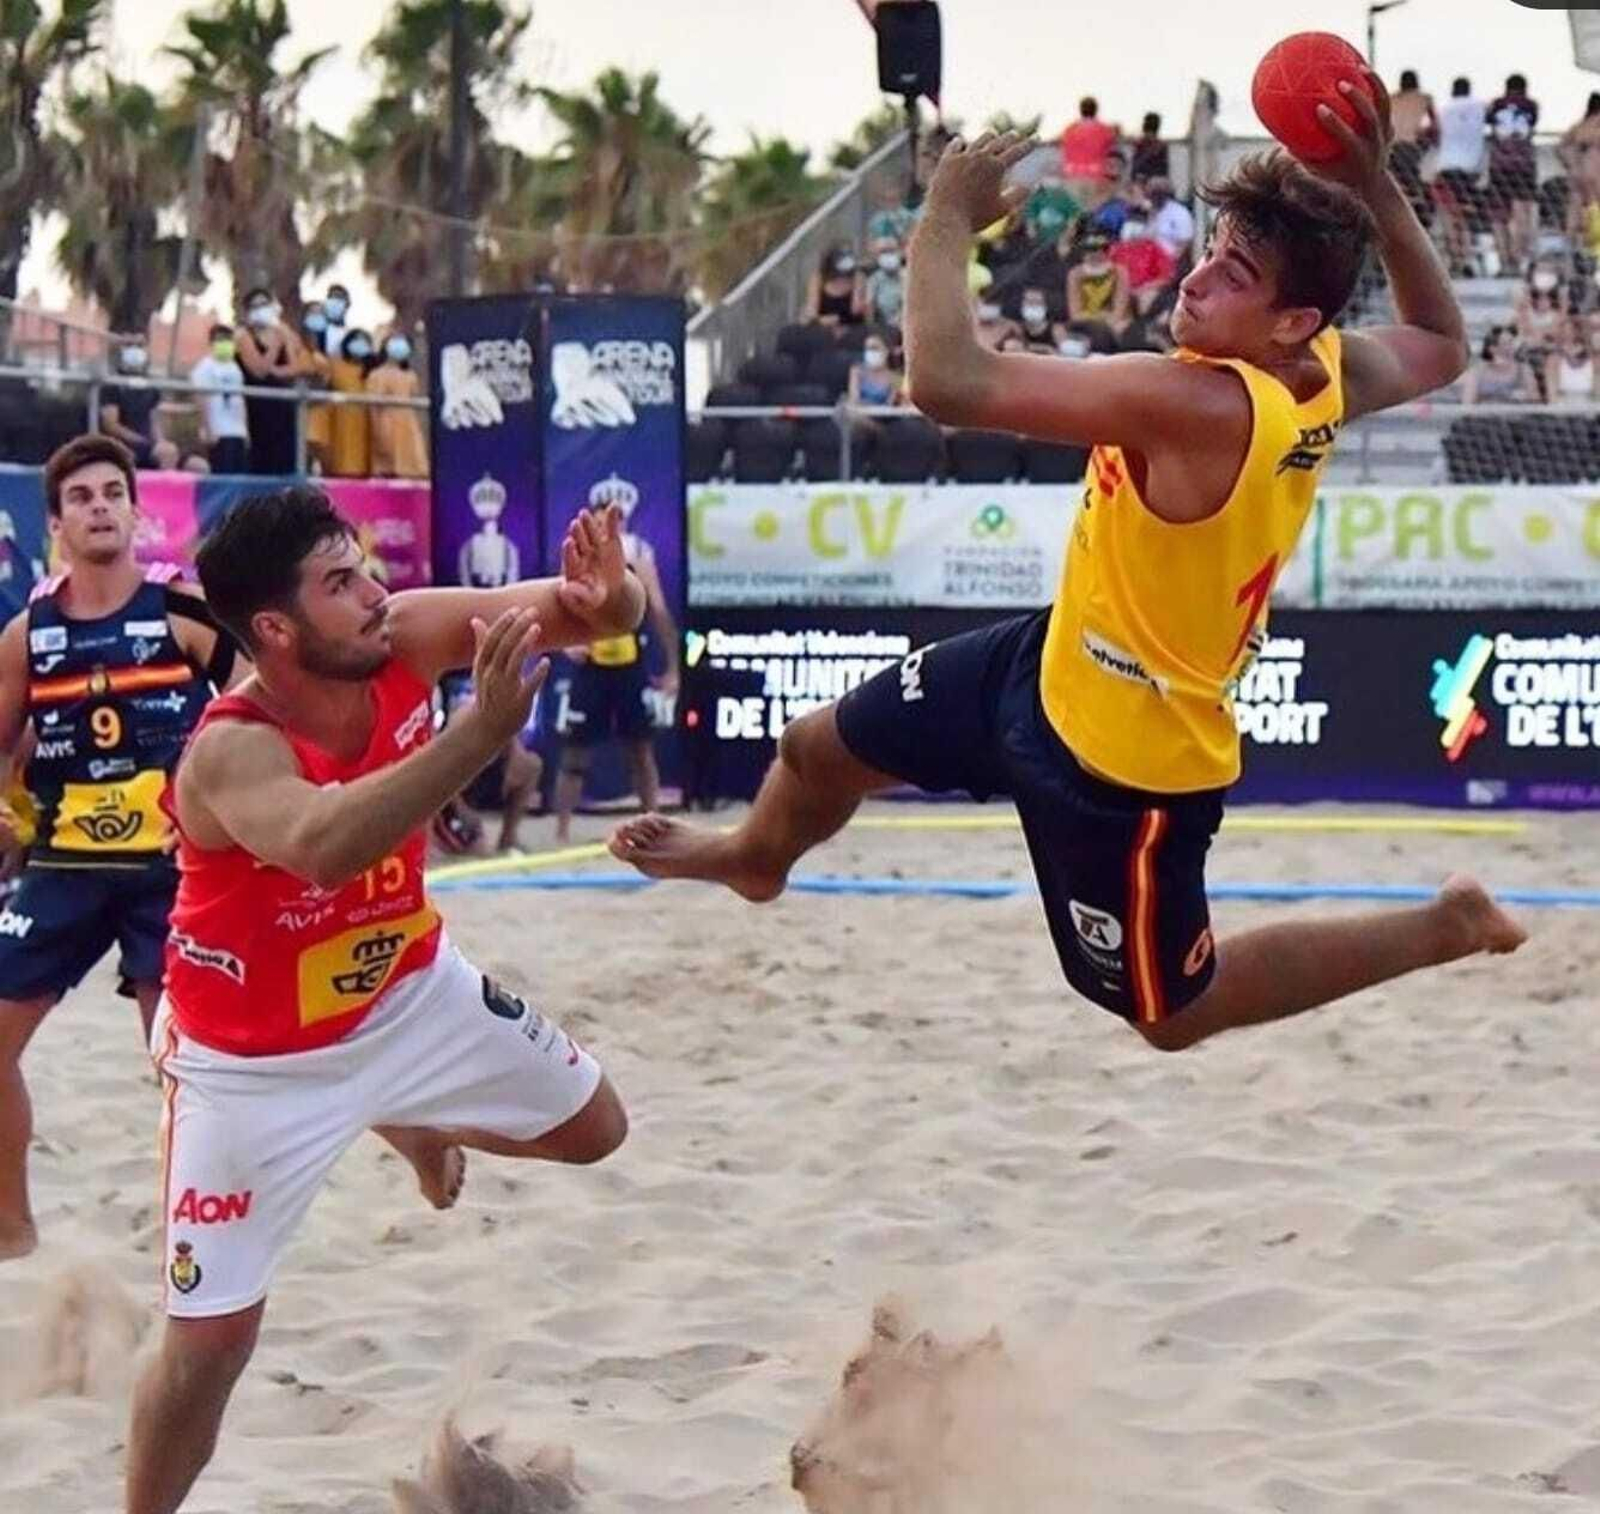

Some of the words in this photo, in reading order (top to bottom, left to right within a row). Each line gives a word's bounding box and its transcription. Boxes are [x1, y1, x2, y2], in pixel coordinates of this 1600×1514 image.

[807, 492, 906, 560] CV
[1336, 494, 1495, 561] PAC
[91, 706, 122, 749] 9
[715, 698, 766, 739] DE
[1507, 705, 1561, 747] DE
[34, 739, 76, 759] AVIS
[173, 1188, 252, 1224] AON
